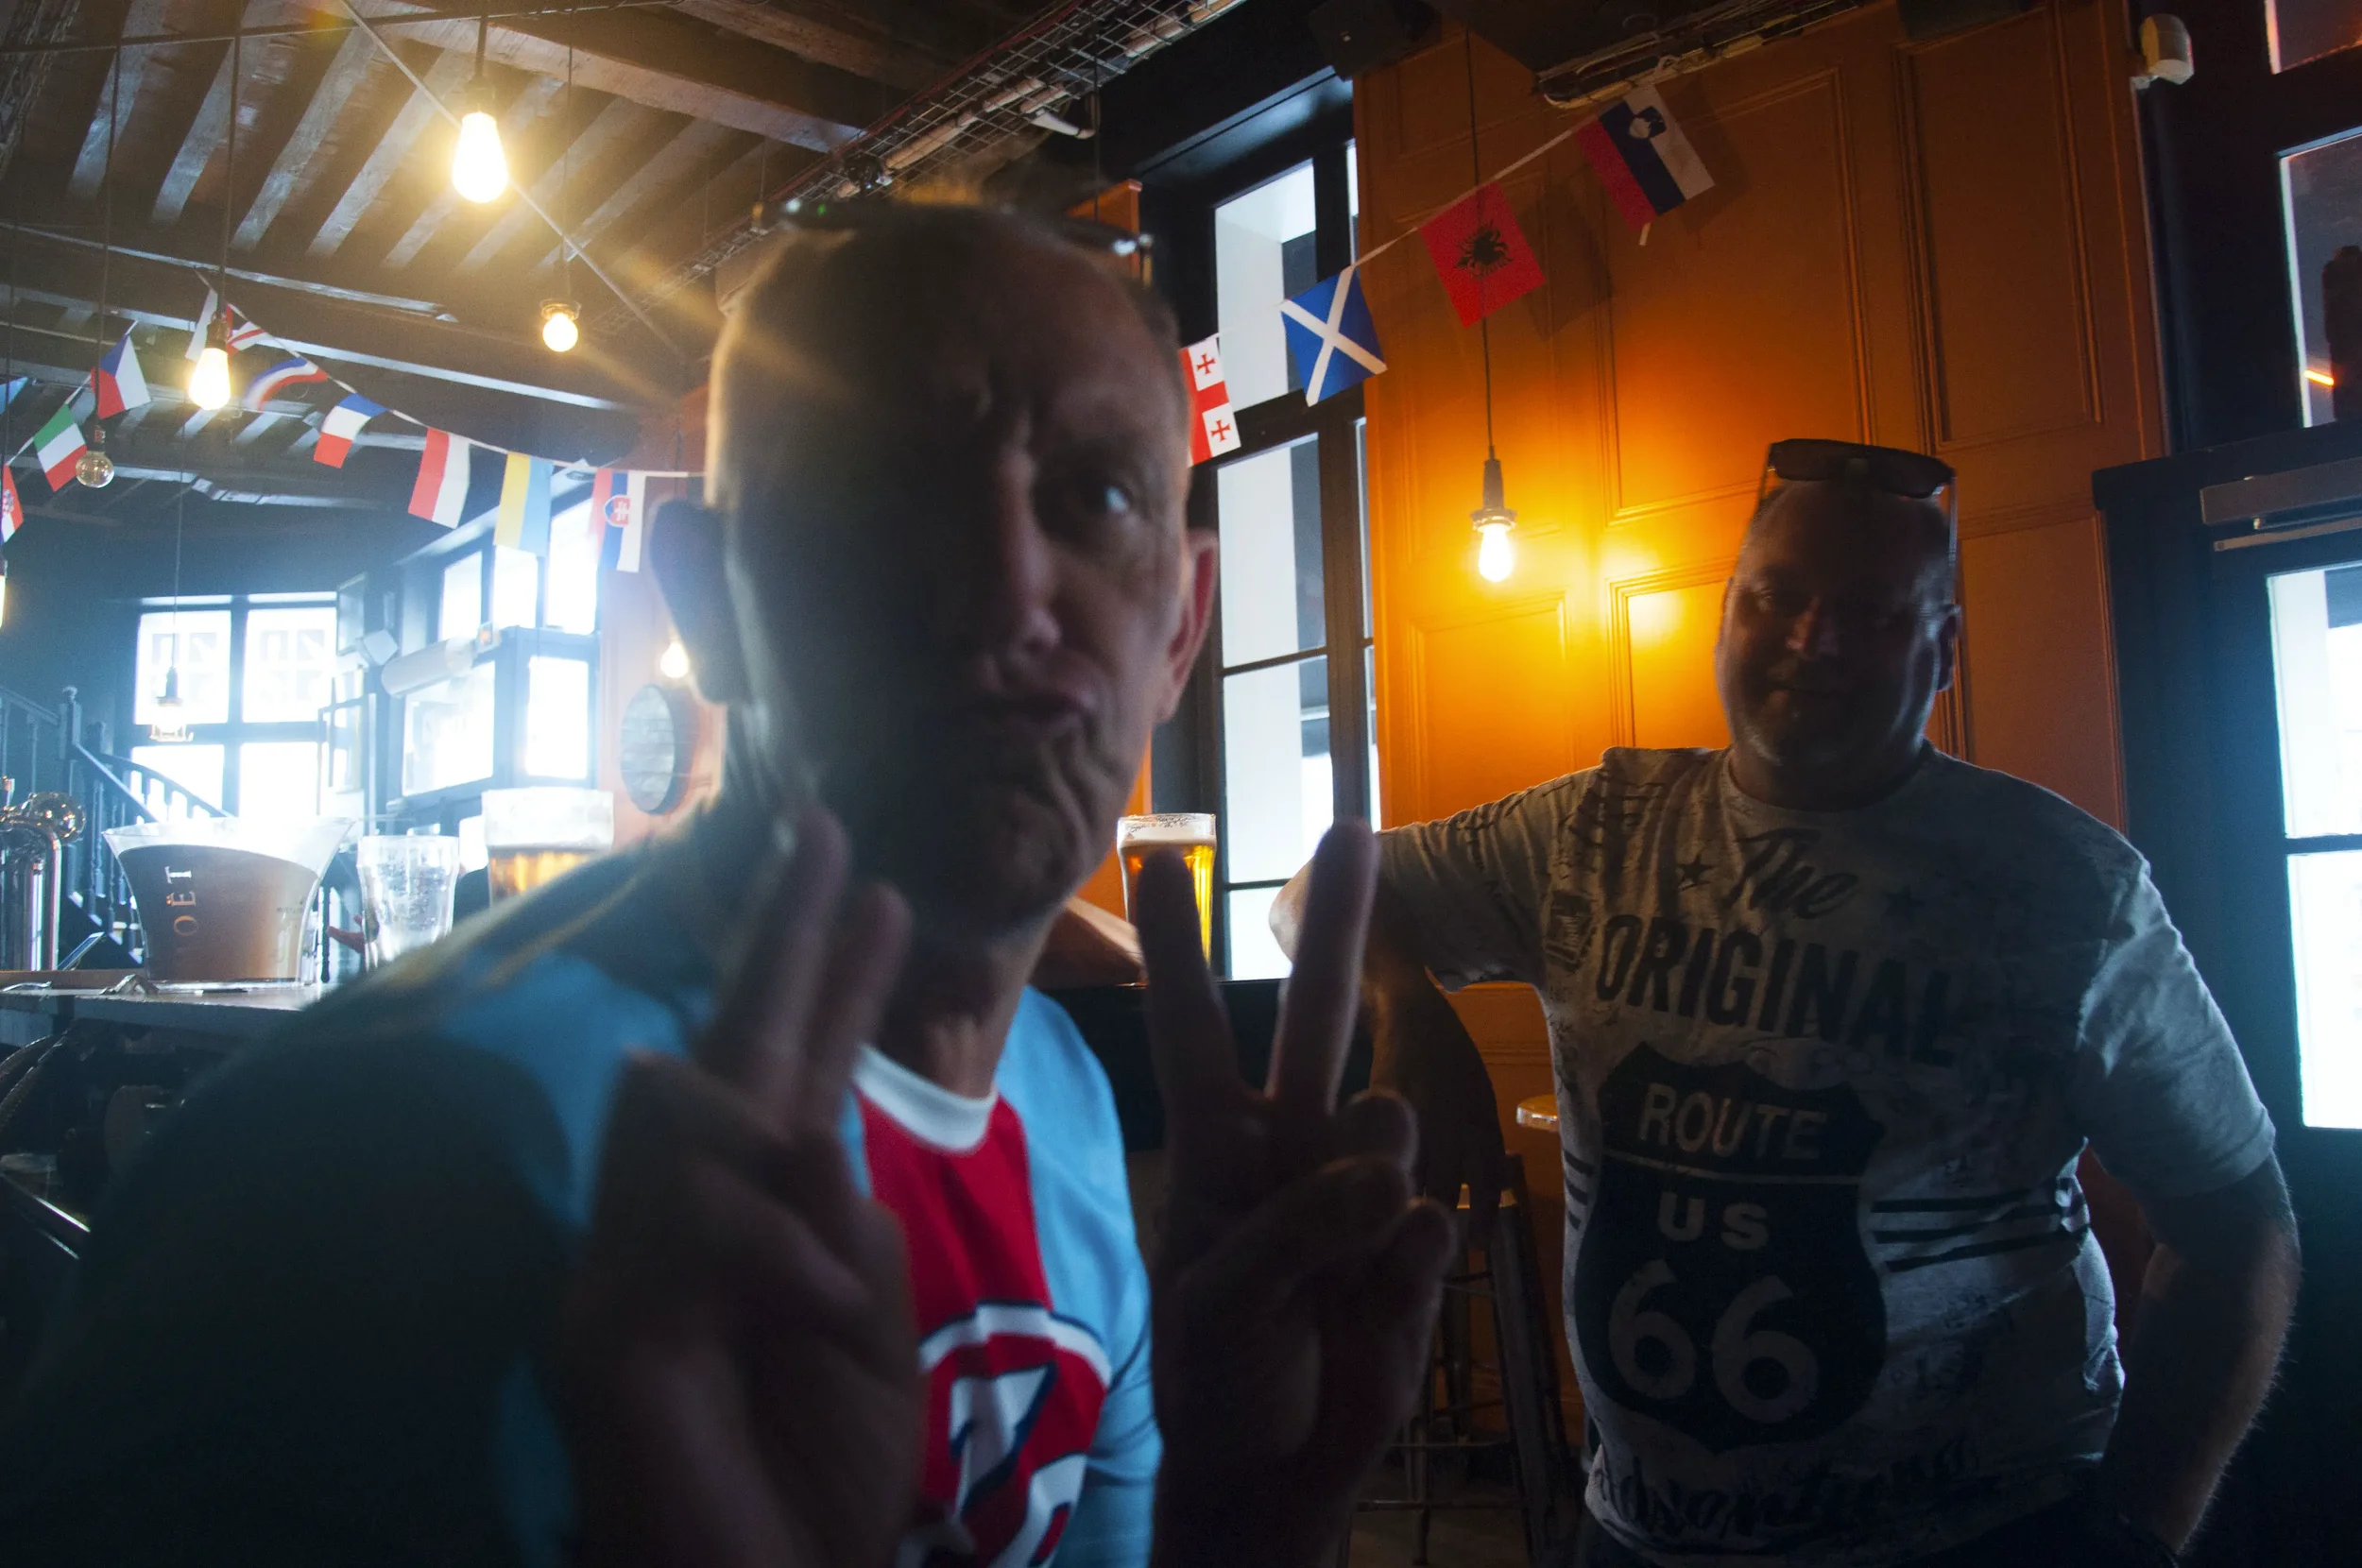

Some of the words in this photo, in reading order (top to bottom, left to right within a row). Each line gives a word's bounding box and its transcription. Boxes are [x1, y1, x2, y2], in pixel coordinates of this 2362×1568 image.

[1721, 826, 1859, 920] The
[1595, 914, 1953, 1066] ORIGINAL
[1638, 1081, 1828, 1162] ROUTE
[1659, 1191, 1771, 1251] US
[1610, 1261, 1819, 1423] 66
